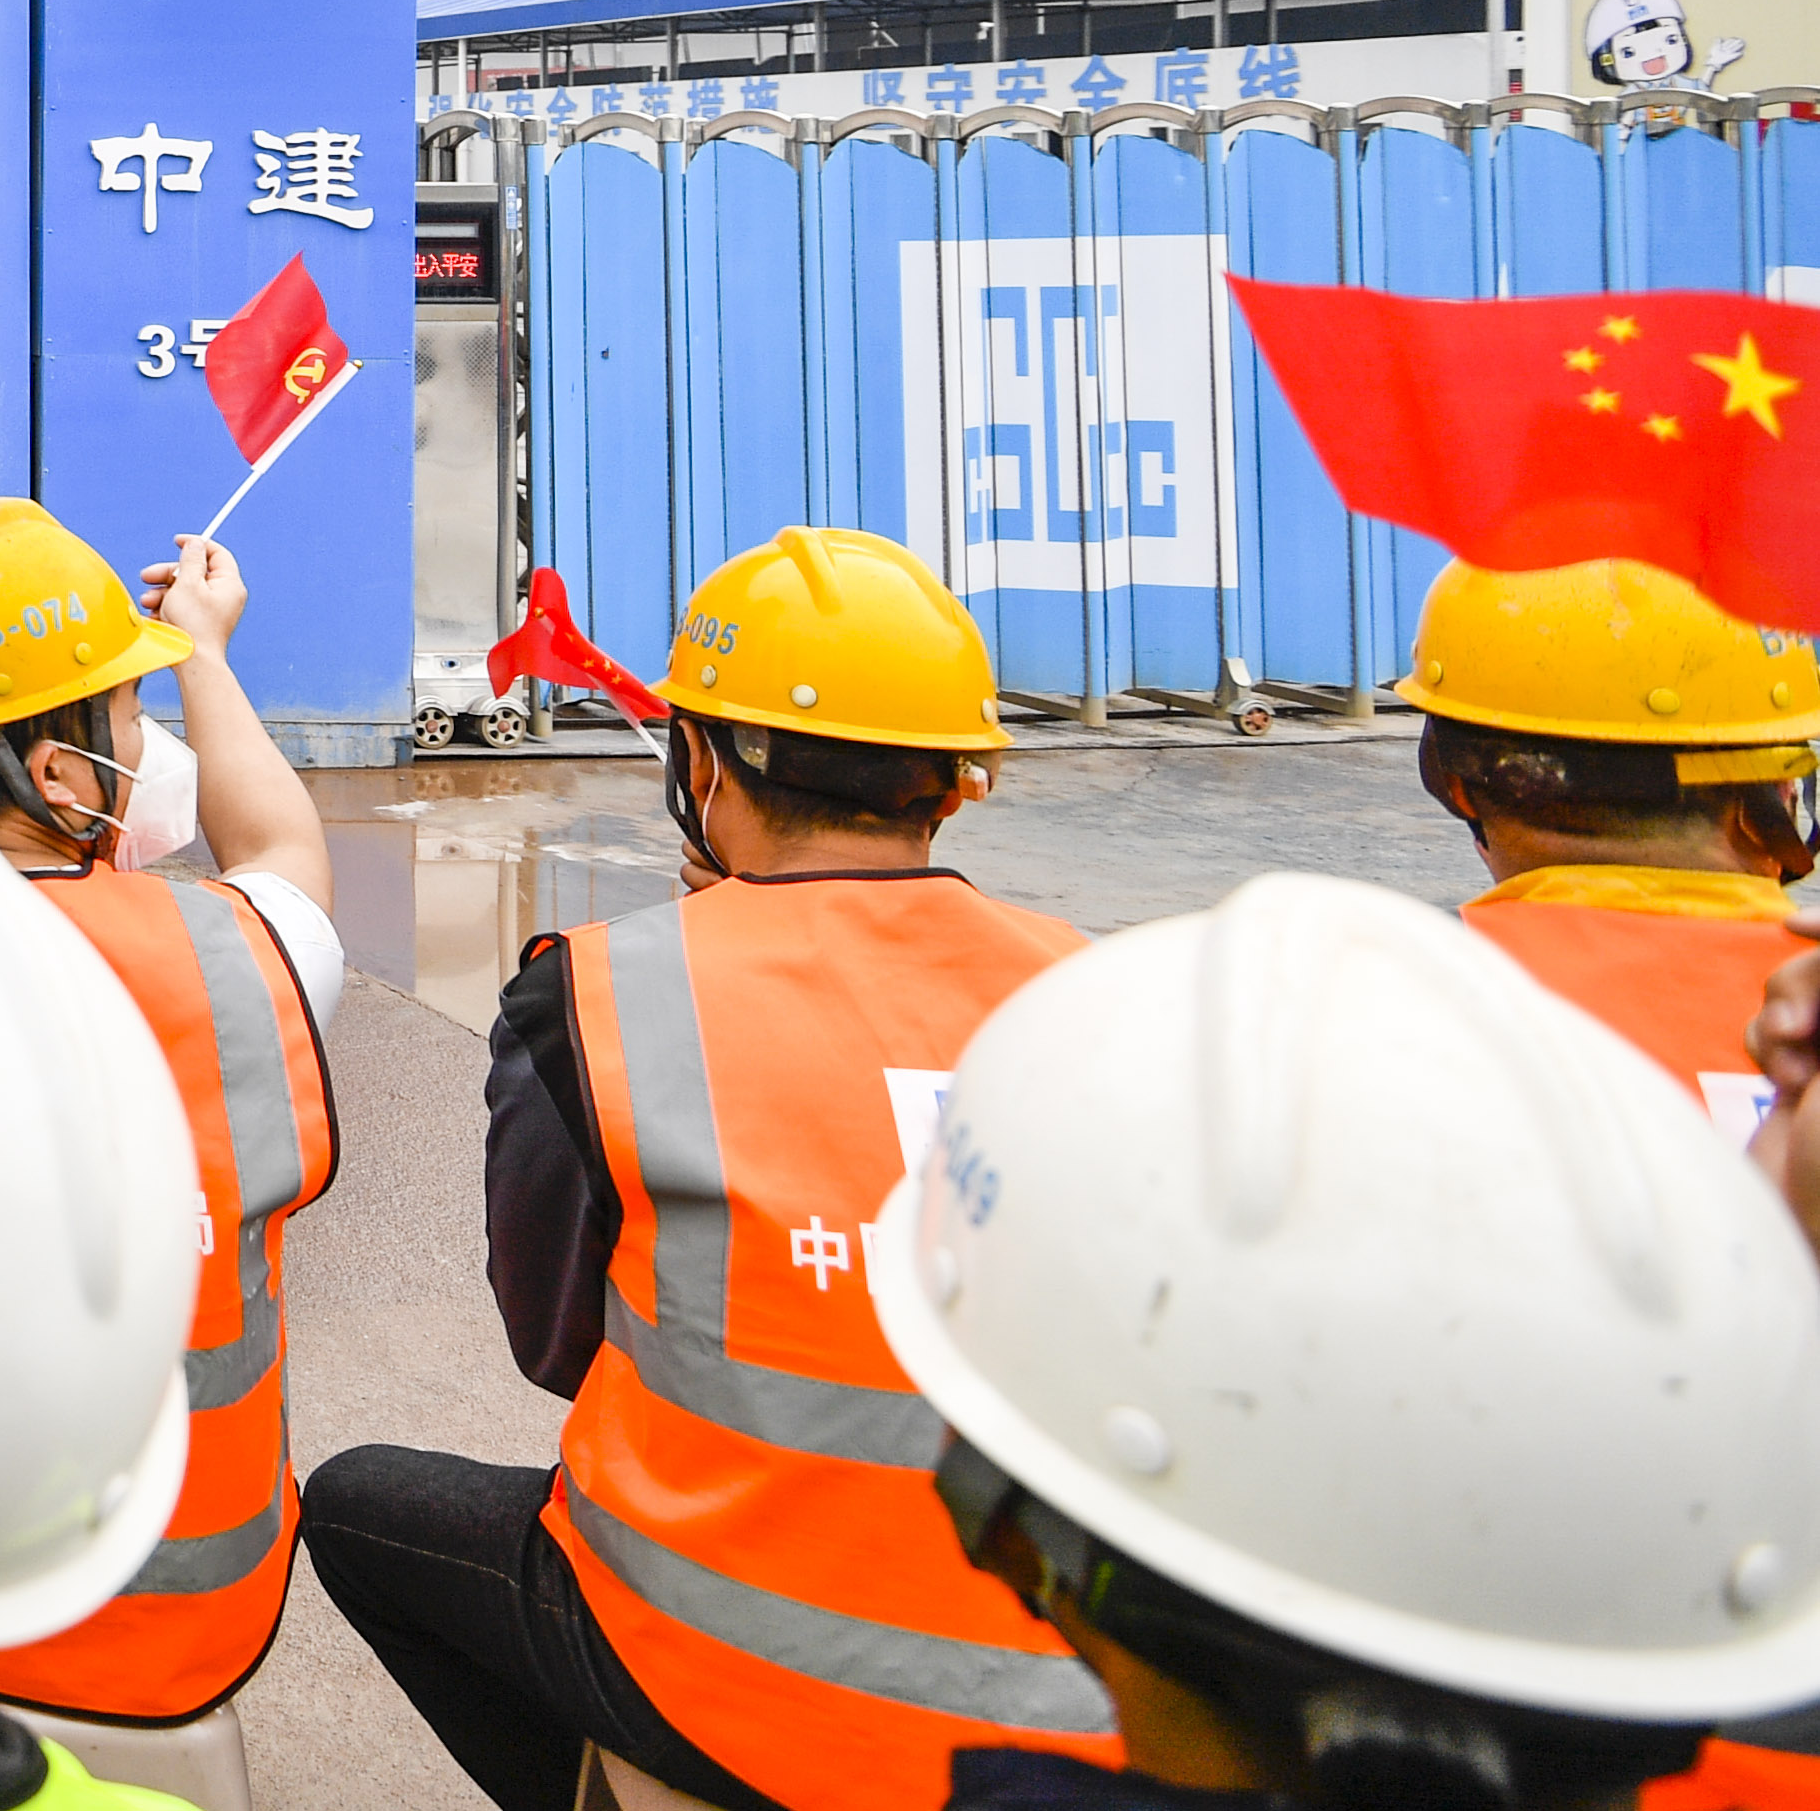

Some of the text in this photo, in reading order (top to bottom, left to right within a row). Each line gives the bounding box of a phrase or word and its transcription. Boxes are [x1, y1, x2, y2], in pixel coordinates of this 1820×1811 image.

[863, 43, 1301, 129] 坚守安全底线
[89, 122, 375, 234] 中建
[413, 252, 479, 278] 出入平安
